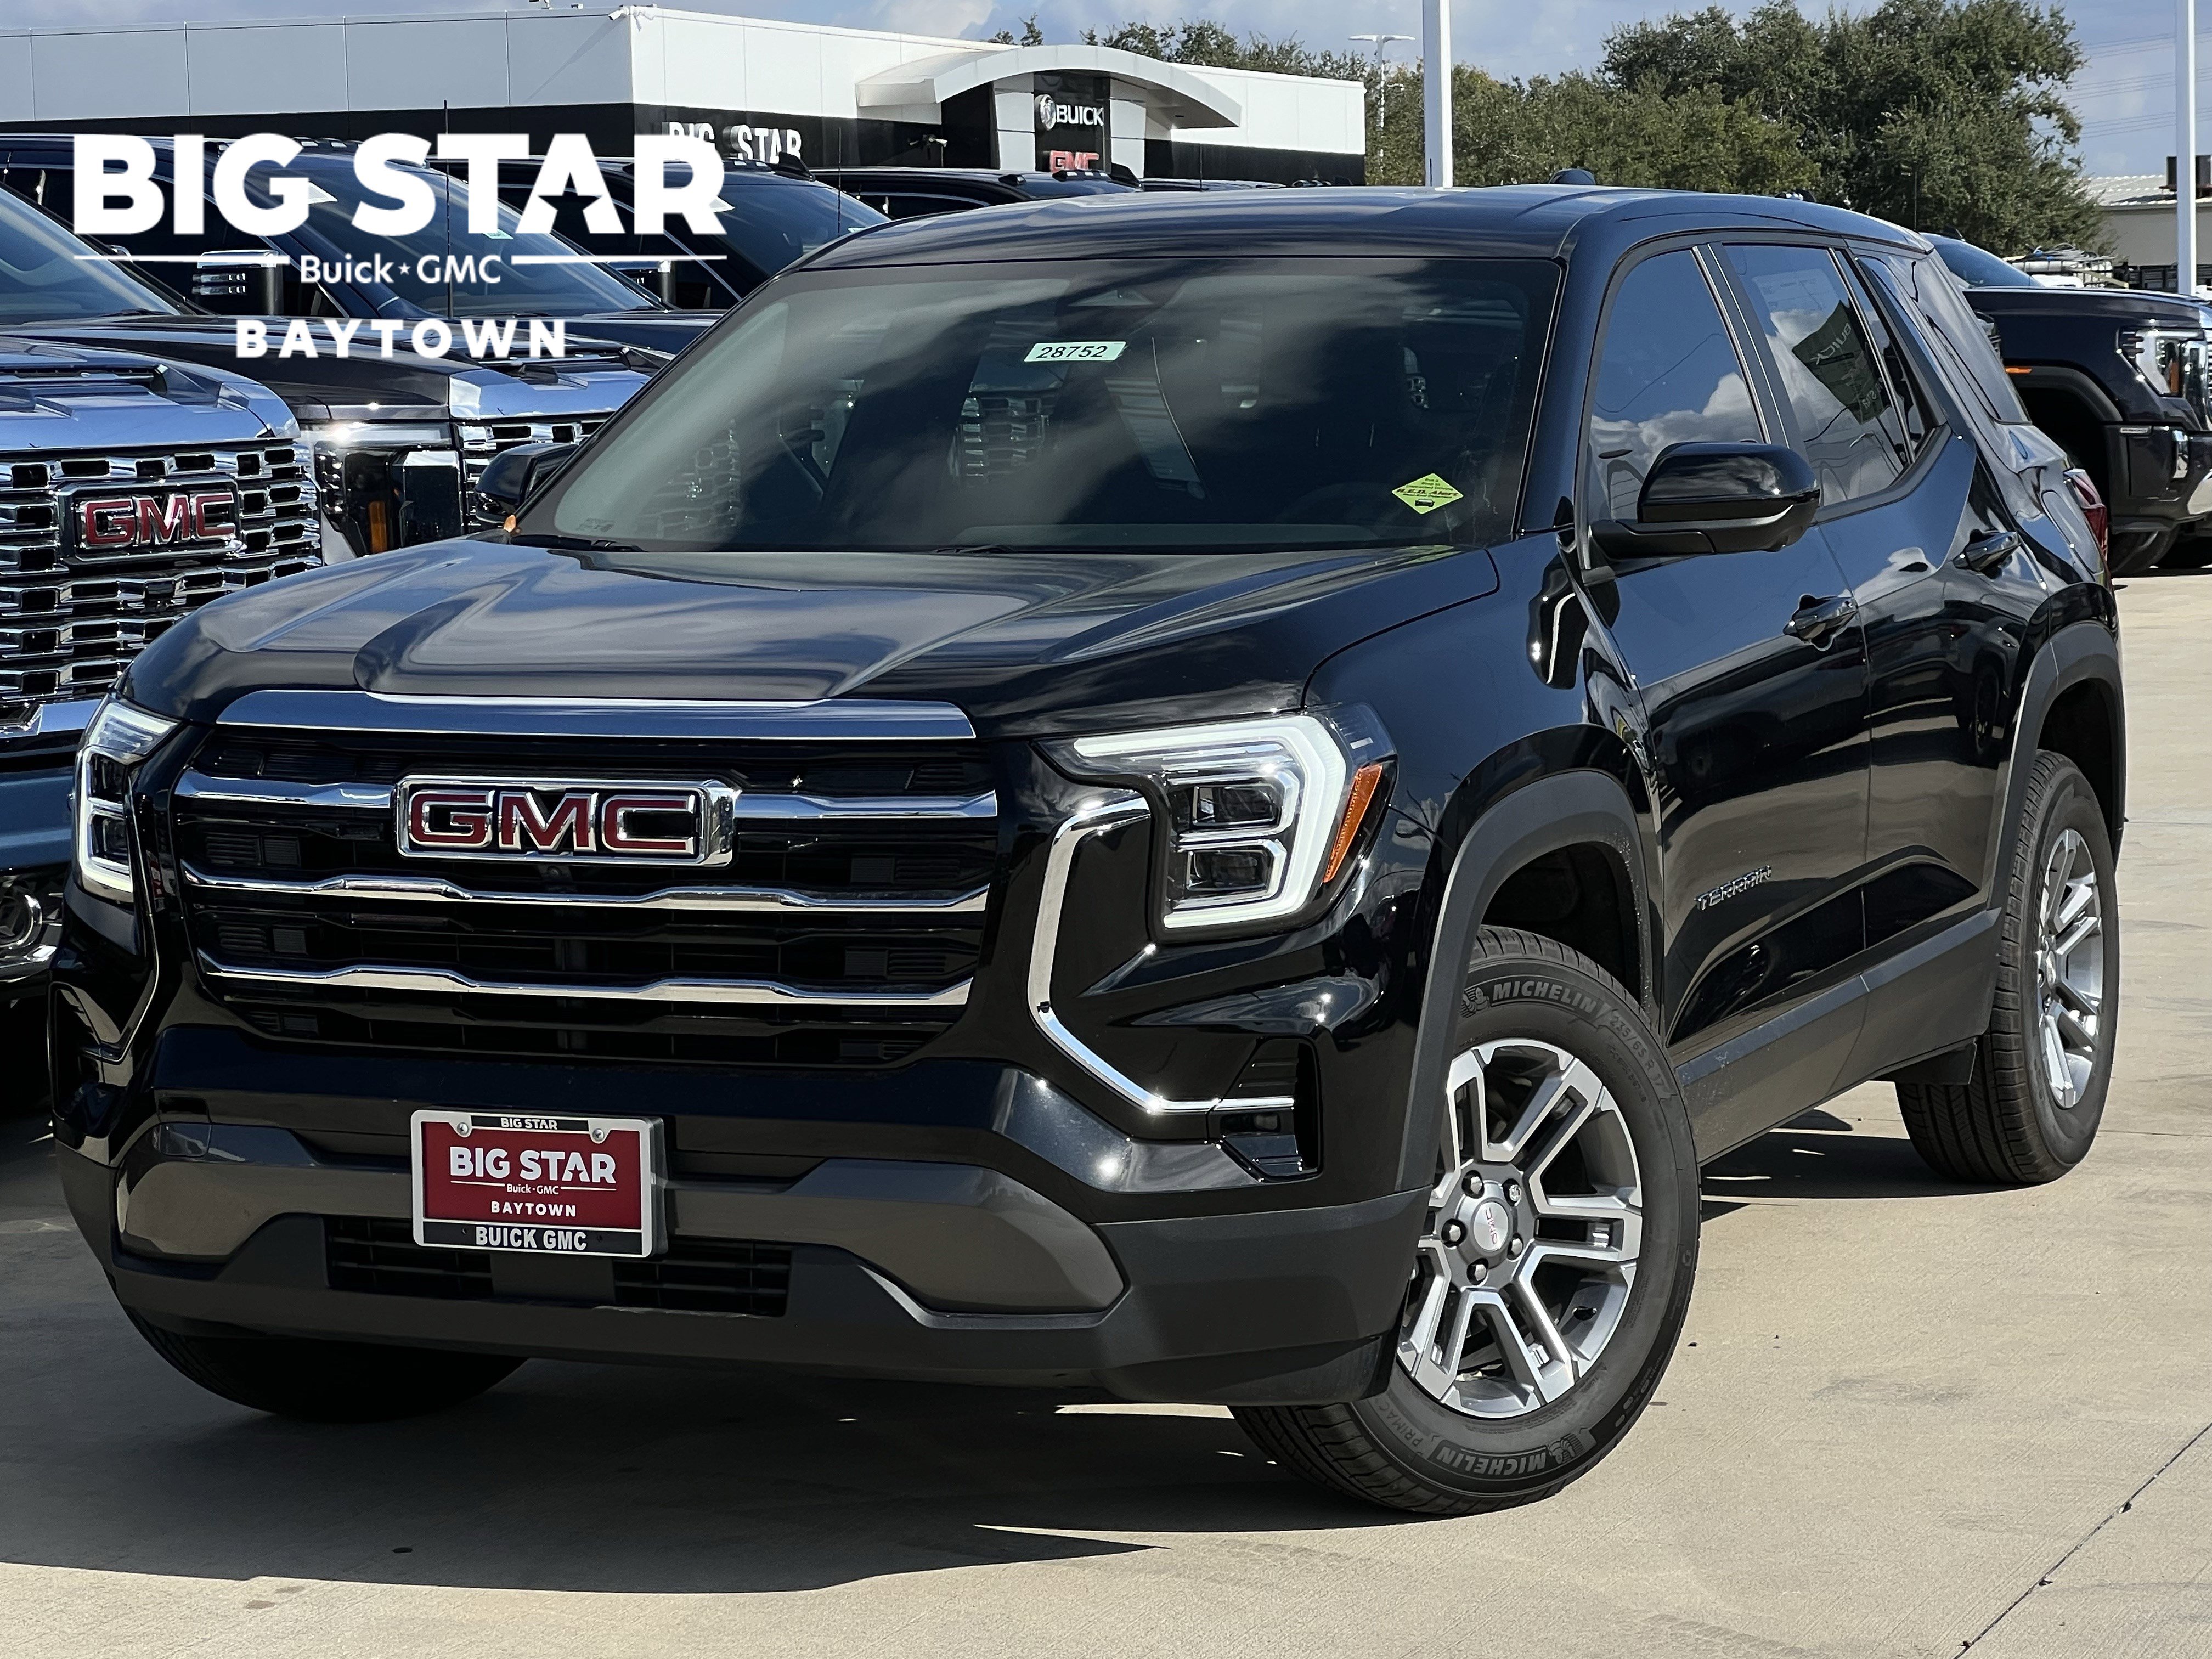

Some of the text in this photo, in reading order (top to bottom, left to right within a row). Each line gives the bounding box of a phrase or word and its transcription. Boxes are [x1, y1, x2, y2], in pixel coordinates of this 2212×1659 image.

[1056, 104, 1104, 126] BUICK
[737, 124, 802, 164] STAR
[1049, 150, 1099, 173] GMC
[1035, 345, 1108, 359] 28752
[82, 492, 237, 548] GMC
[408, 789, 696, 855] GMC
[1694, 864, 1772, 911] TERRAIN
[1492, 980, 1598, 1014] MICHELIN
[1610, 1015, 1647, 1058] 235/65
[1645, 1059, 1655, 1070] R
[501, 1117, 557, 1131] BIG STAR
[449, 1146, 616, 1184] BIG STAR
[506, 1183, 560, 1195] Buick GMC
[491, 1201, 576, 1217] BAYTOWN
[1485, 1207, 1497, 1245] GMC
[475, 1226, 587, 1251] BUICK GMC
[1375, 1398, 1424, 1447] PRIMAC
[1436, 1446, 1547, 1476] MICHELIN
